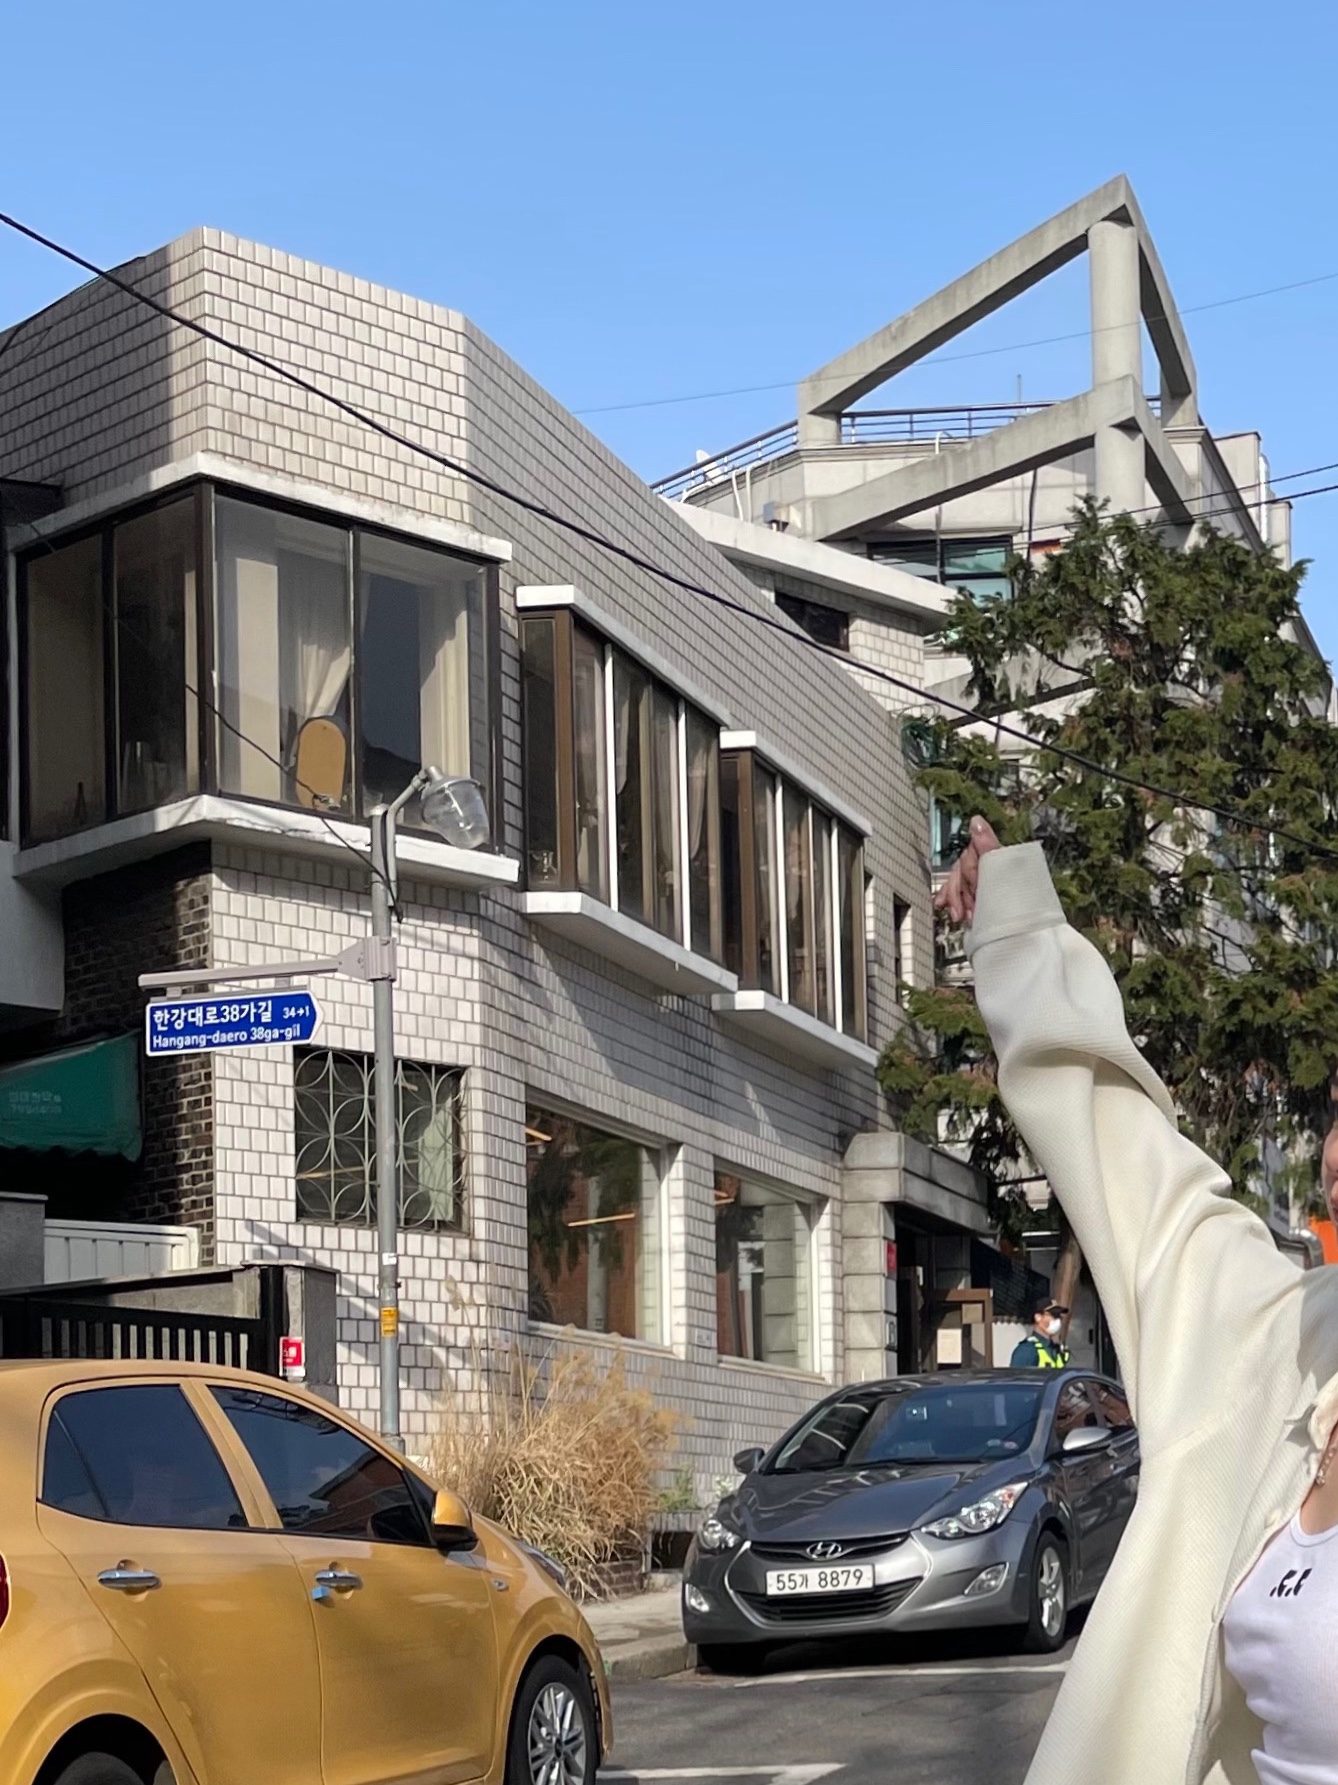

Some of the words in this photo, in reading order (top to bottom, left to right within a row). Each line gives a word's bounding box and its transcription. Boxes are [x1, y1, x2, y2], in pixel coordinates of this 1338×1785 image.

[153, 1000, 272, 1031] 한강대로38가길
[153, 1031, 248, 1049] Hangang-daero
[250, 1024, 300, 1042] 38ga-gil
[776, 1573, 809, 1591] 55가
[818, 1568, 863, 1588] 8879
